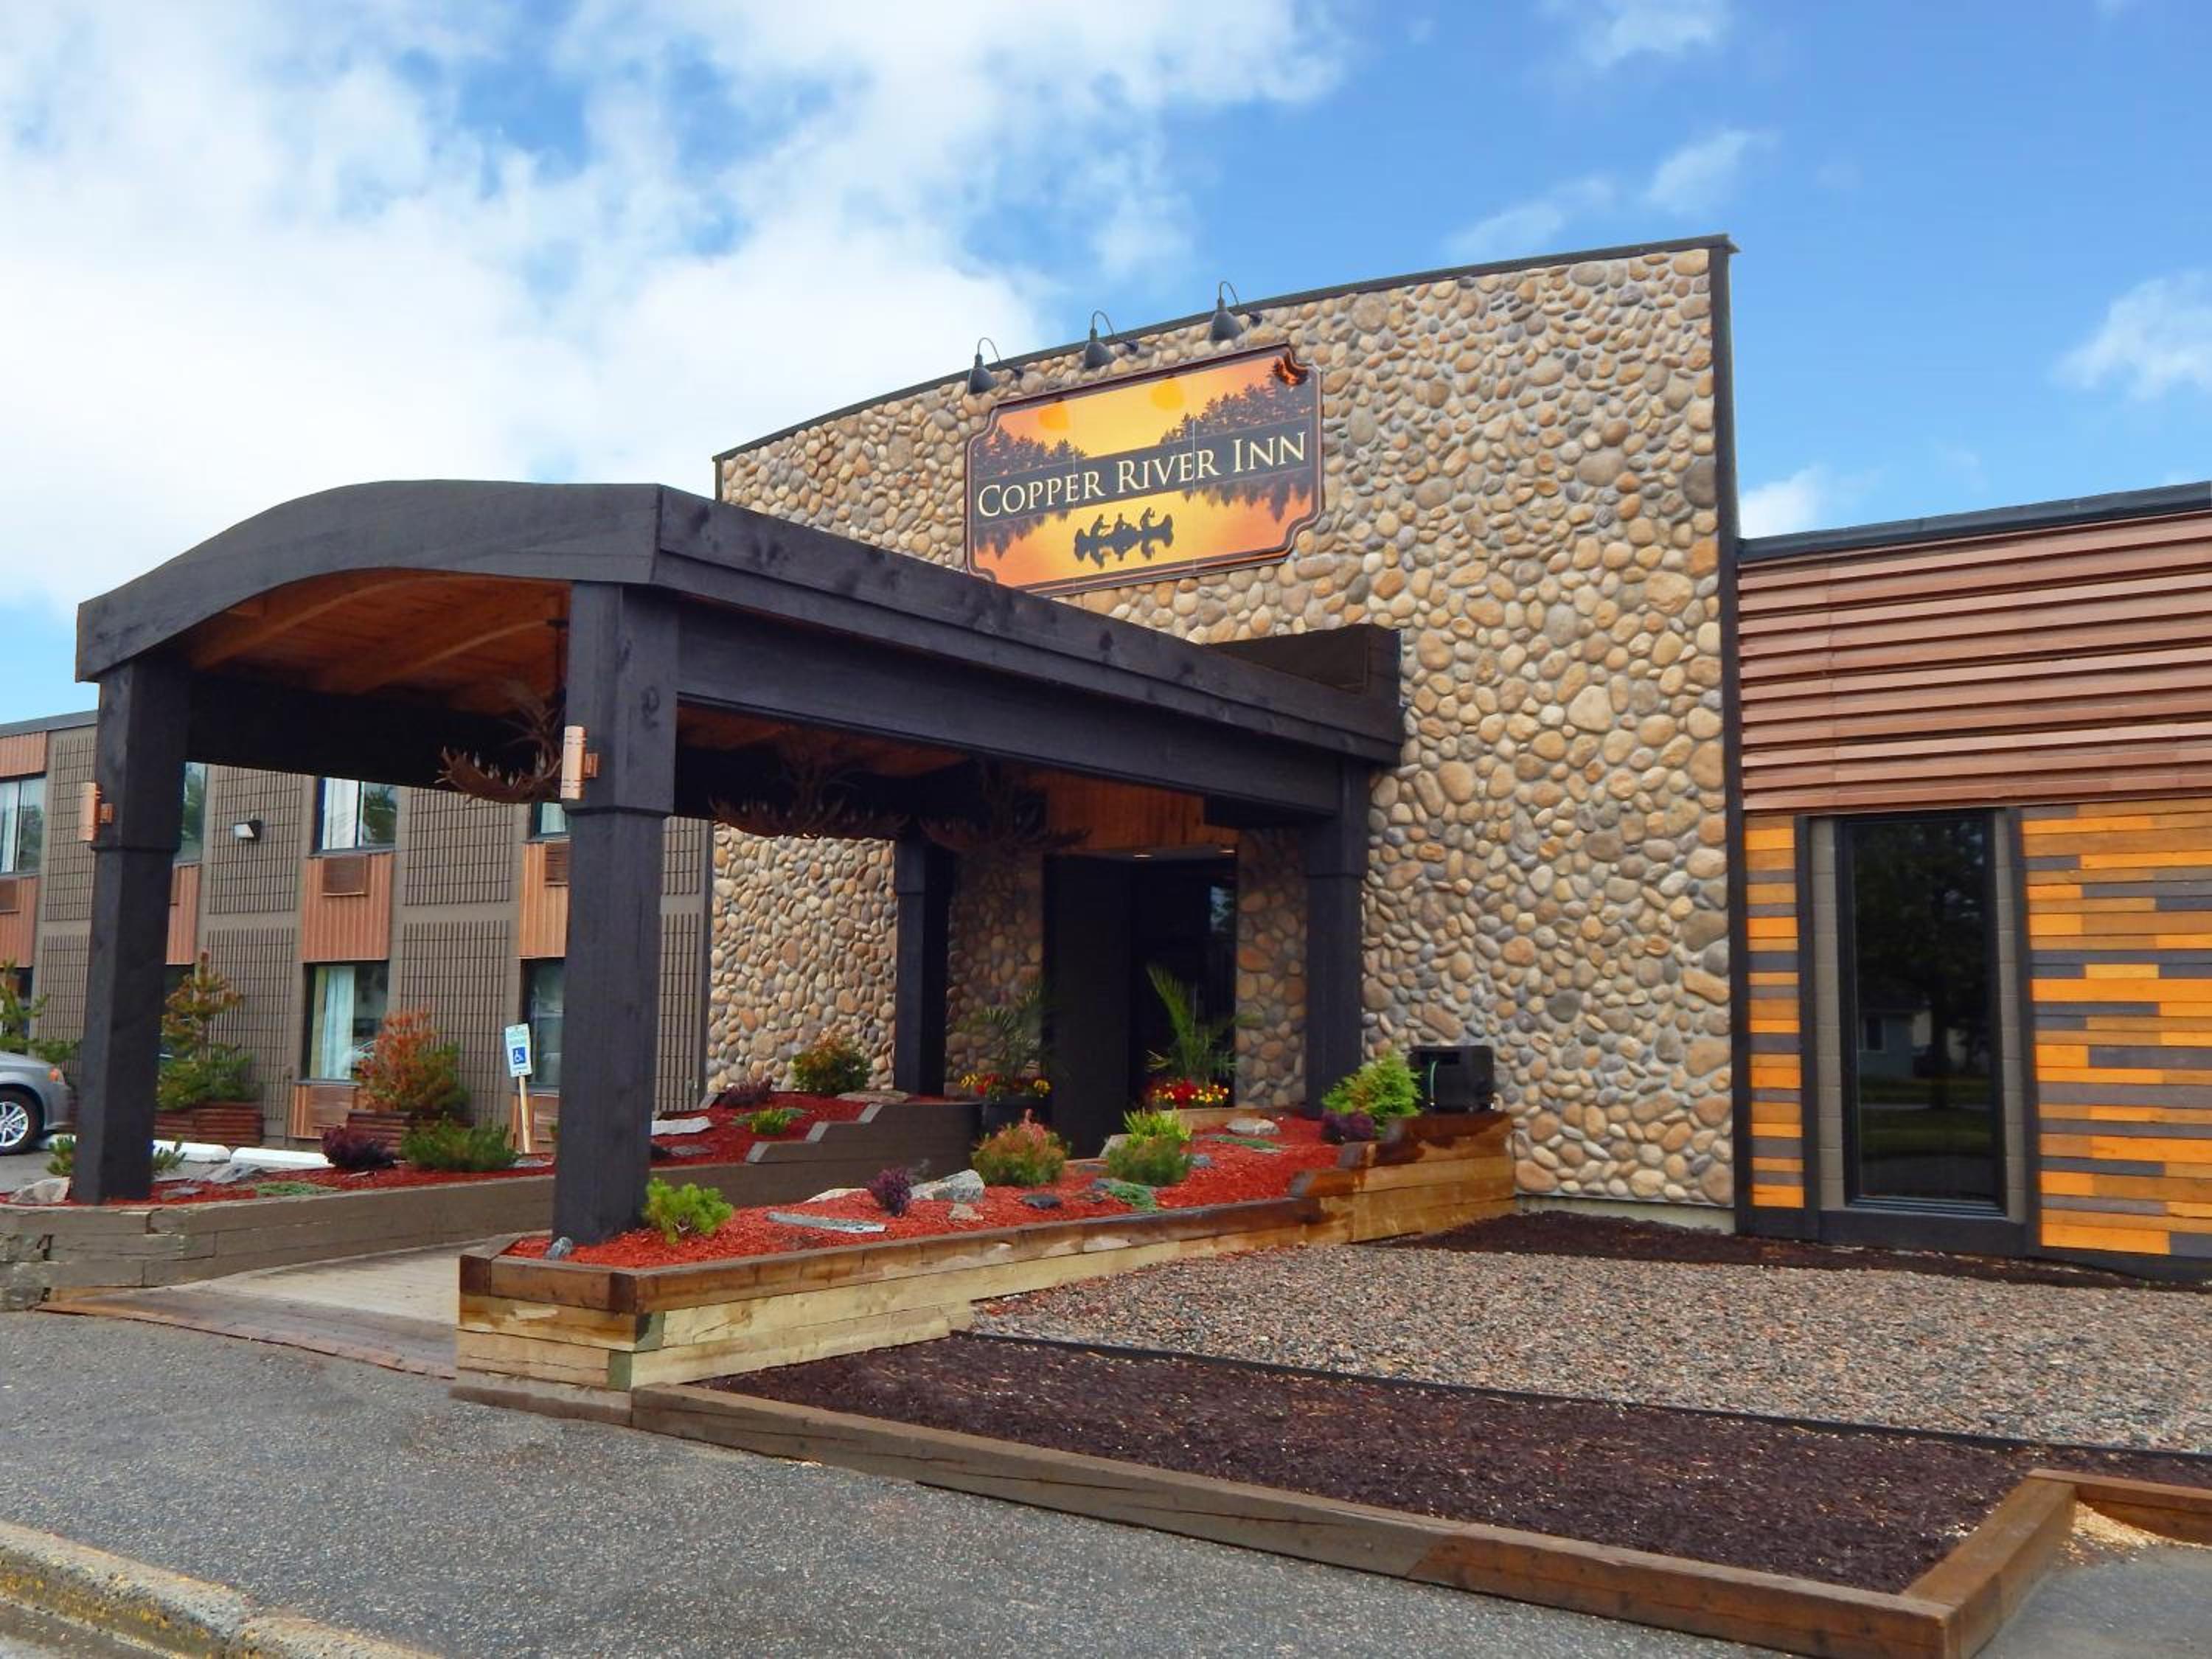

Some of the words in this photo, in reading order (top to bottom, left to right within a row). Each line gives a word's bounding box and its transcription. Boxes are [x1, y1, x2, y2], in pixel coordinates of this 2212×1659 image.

[978, 470, 1106, 518] COPPER
[1117, 448, 1220, 493] RIVER
[1233, 431, 1307, 473] INN
